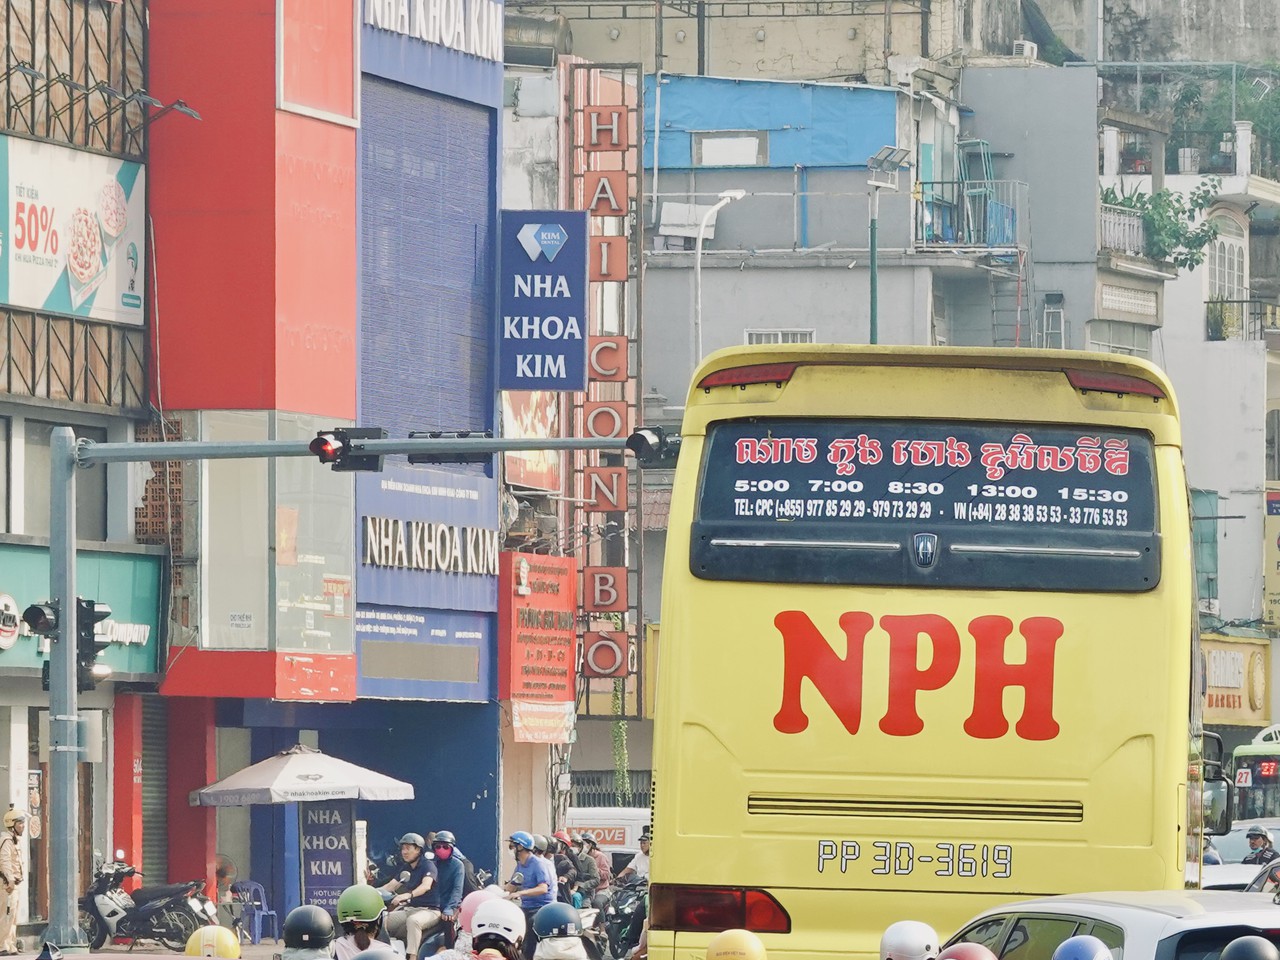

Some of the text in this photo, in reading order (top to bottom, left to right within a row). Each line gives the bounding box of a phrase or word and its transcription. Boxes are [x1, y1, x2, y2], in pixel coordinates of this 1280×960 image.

[409, 0, 465, 52] KHOA
[465, 0, 503, 62] KIM
[15, 201, 58, 256] 50%
[541, 231, 560, 240] KIM
[514, 275, 571, 298] NHA
[503, 316, 582, 340] KHOA
[516, 354, 567, 378] KIM
[734, 480, 1128, 502] 5:00 7:00 8:30 13:00 15:30
[734, 499, 753, 516] TEL:
[755, 500, 773, 517] CPC
[775, 499, 804, 518] (+855)
[806, 500, 824, 517] 977
[825, 501, 837, 517] 85
[839, 501, 852, 517] 29
[853, 501, 865, 518] 29
[873, 501, 889, 518] 979
[892, 501, 904, 518] 73
[905, 501, 918, 518] 29
[919, 501, 931, 519] 29
[954, 502, 967, 520] VN
[968, 503, 992, 522] (+84)
[995, 503, 1007, 521] 28
[1008, 504, 1020, 521] 38
[1022, 504, 1034, 522] 38
[1036, 505, 1048, 522] 53
[1050, 505, 1061, 523] 53
[1069, 506, 1081, 524] 33
[1083, 507, 1100, 525] 776
[1102, 508, 1114, 526] 53
[1116, 509, 1128, 527] 53
[364, 516, 499, 575] NHA KHOA KIM
[773, 610, 1065, 740] NPH
[1208, 694, 1242, 709] MARKET
[1237, 771, 1250, 784] 27
[1261, 762, 1276, 776] 27
[290, 789, 346, 797] nhakhoakim.com
[307, 810, 342, 824] NHA
[302, 836, 350, 850] KHOA
[310, 861, 342, 876] KIM
[817, 840, 1012, 879] PP 3D-3619
